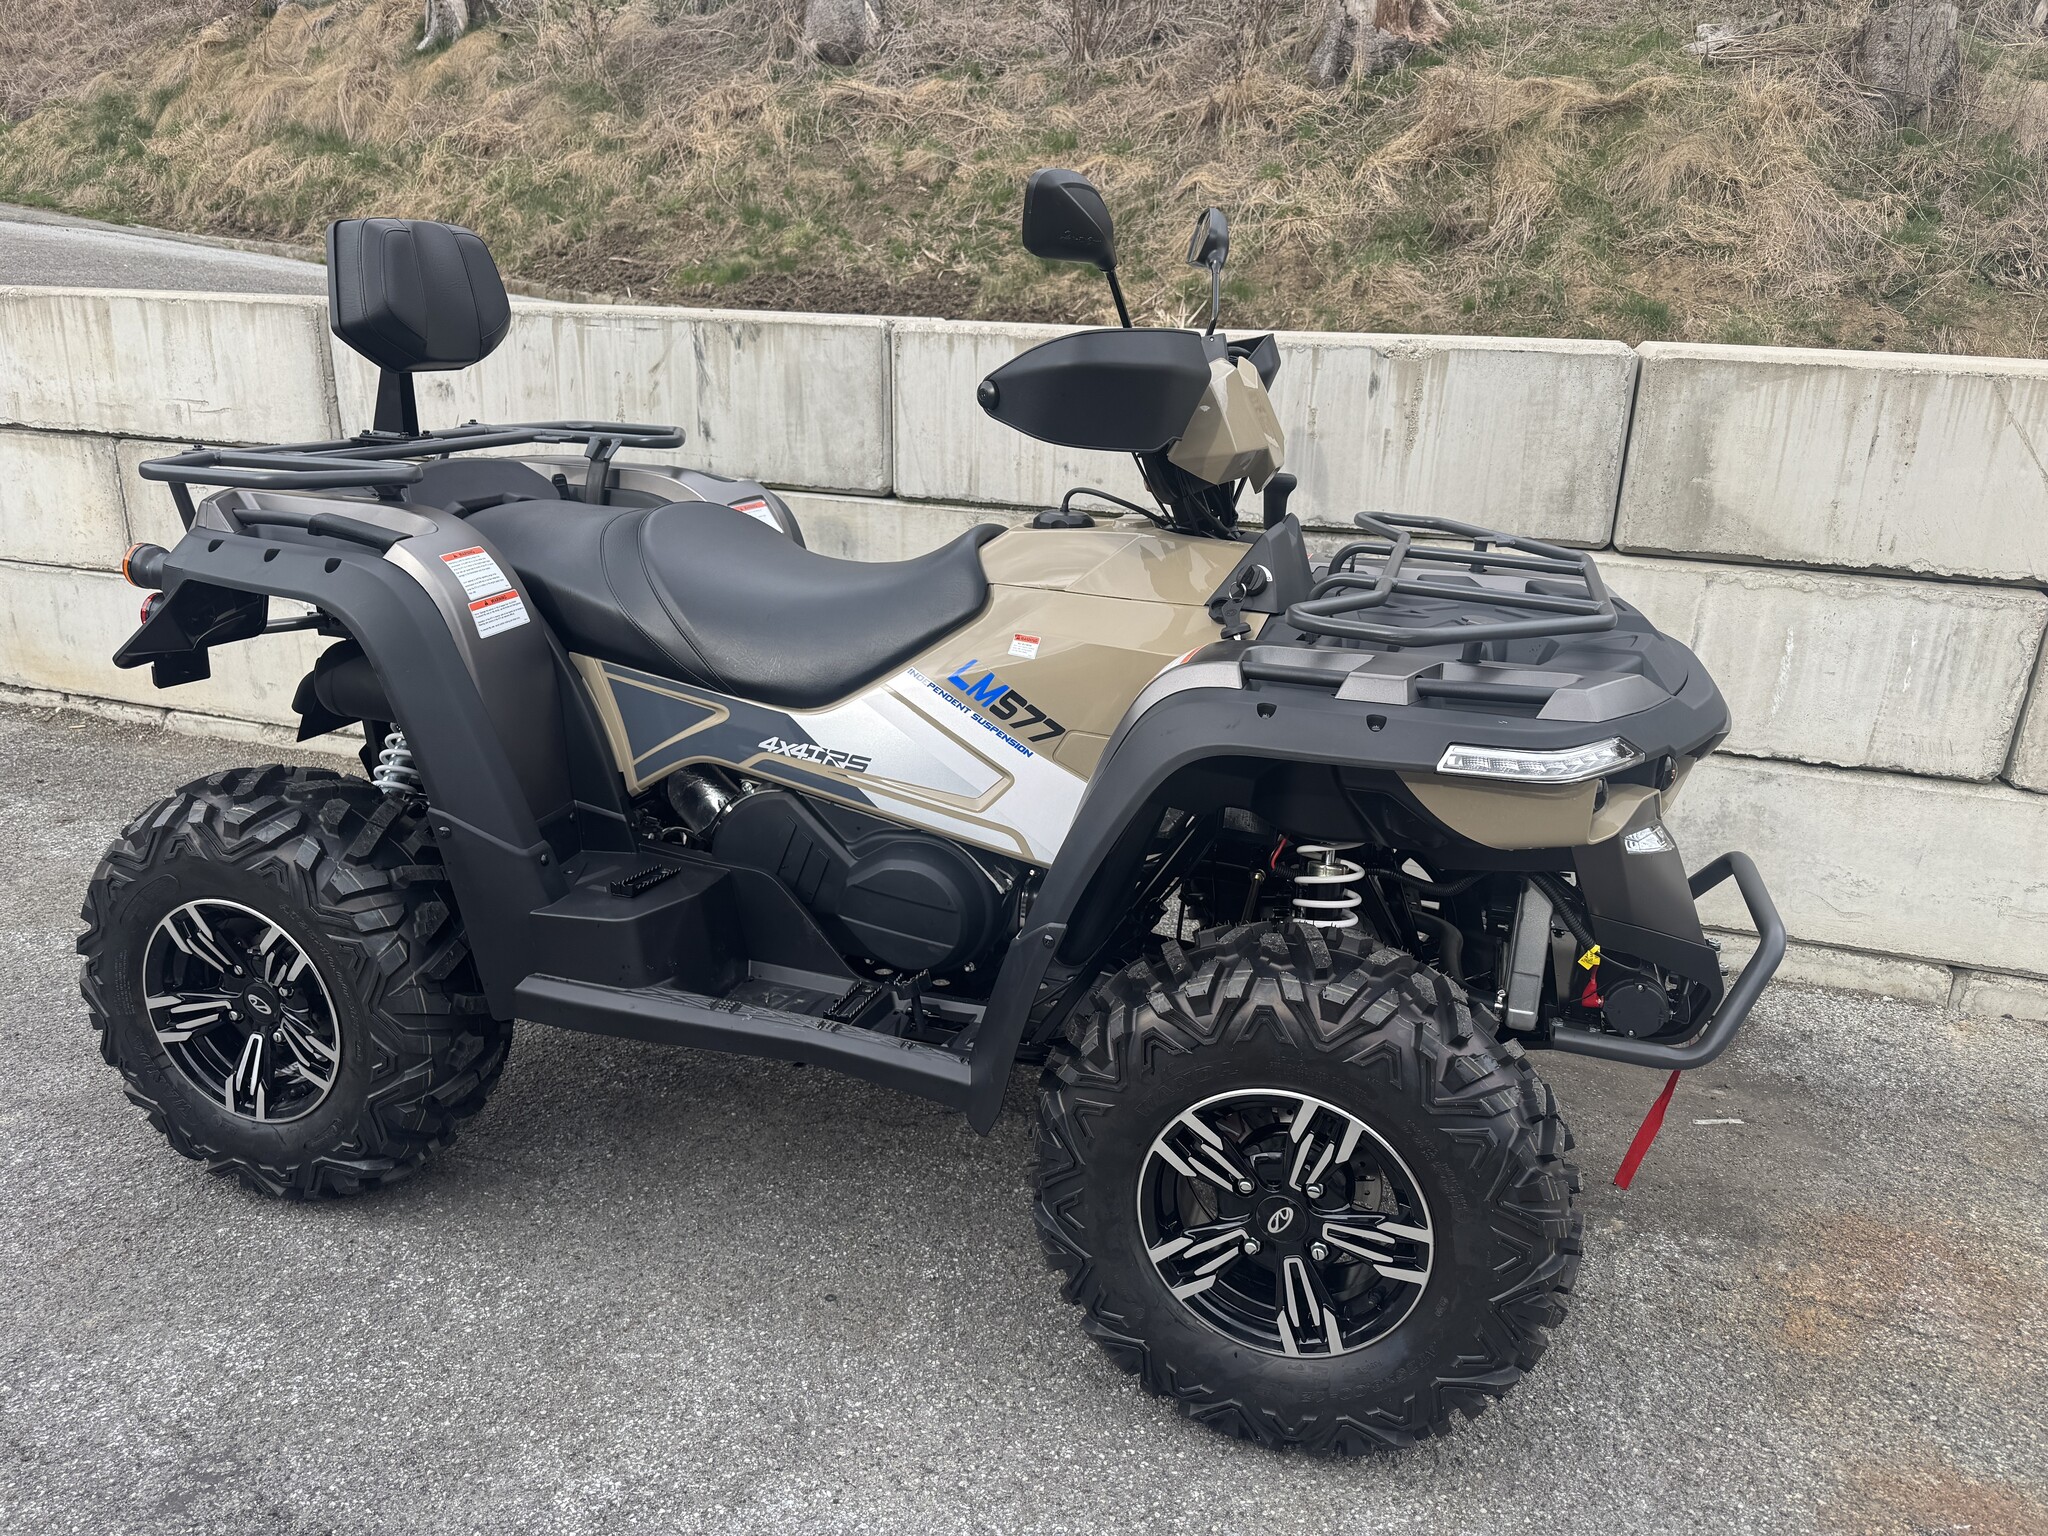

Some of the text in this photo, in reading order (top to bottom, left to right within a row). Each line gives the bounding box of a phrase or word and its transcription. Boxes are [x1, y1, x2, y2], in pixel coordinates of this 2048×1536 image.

[907, 668, 1035, 758] INDEPENDENT SUSPENSION
[947, 659, 1066, 743] LM577
